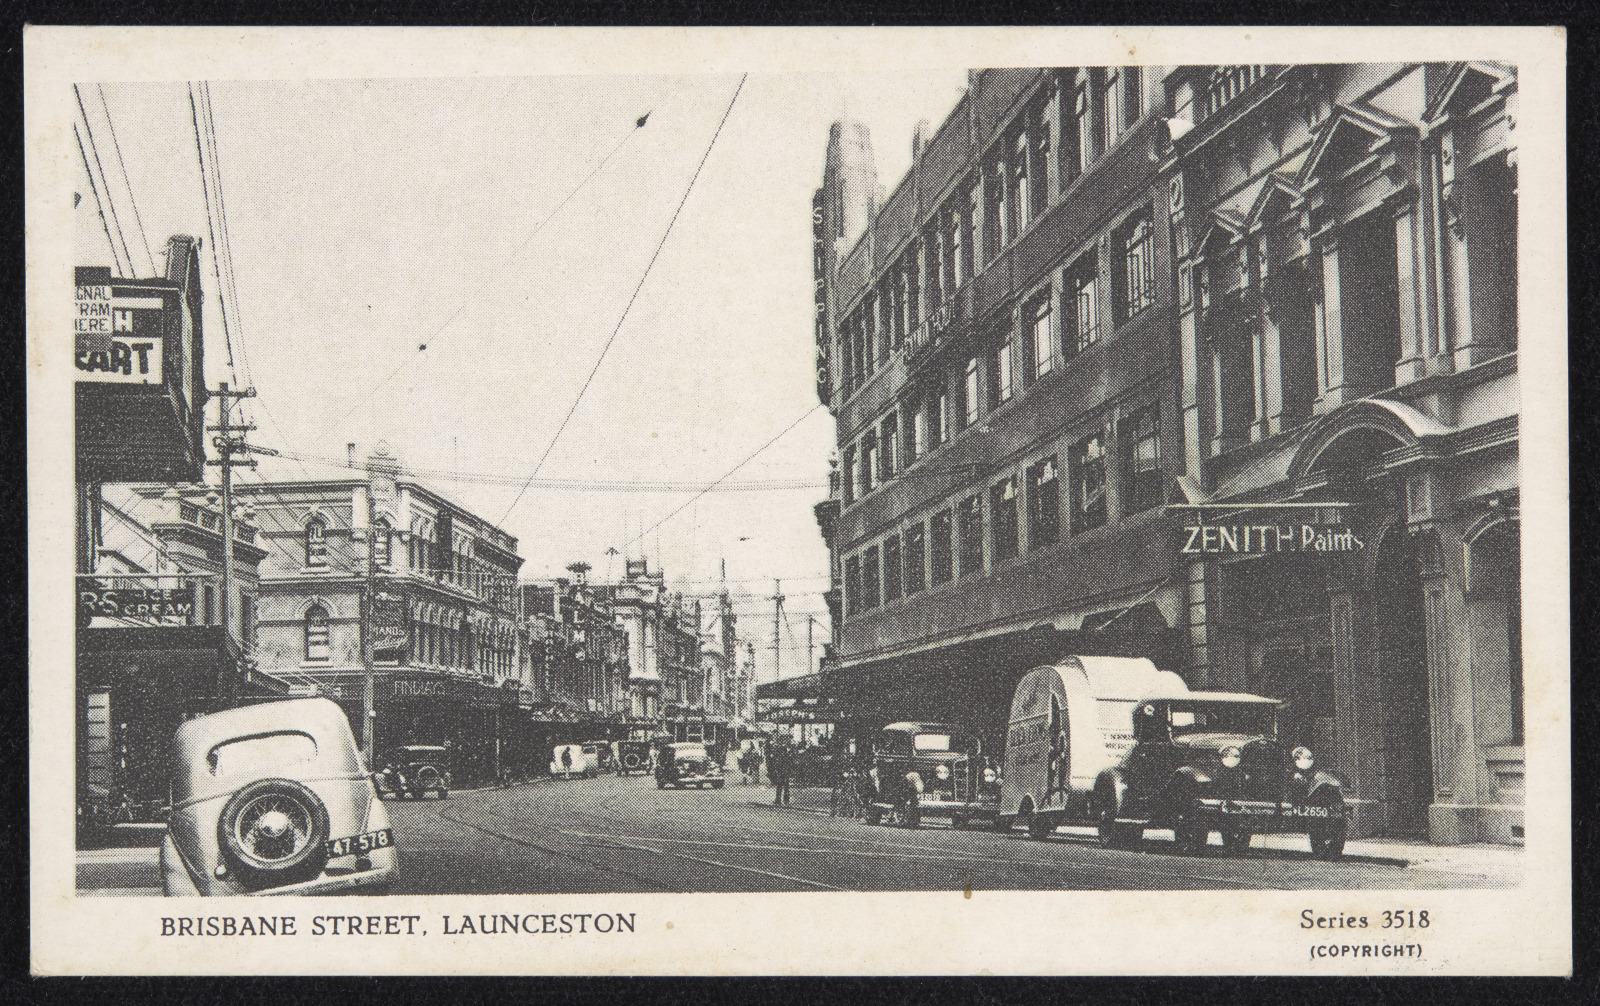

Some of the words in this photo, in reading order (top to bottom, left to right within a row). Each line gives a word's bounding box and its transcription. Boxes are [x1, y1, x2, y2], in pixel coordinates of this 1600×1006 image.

[75, 303, 110, 316] RAM
[1183, 525, 1294, 553] ZENITH
[124, 602, 191, 615] CREAM
